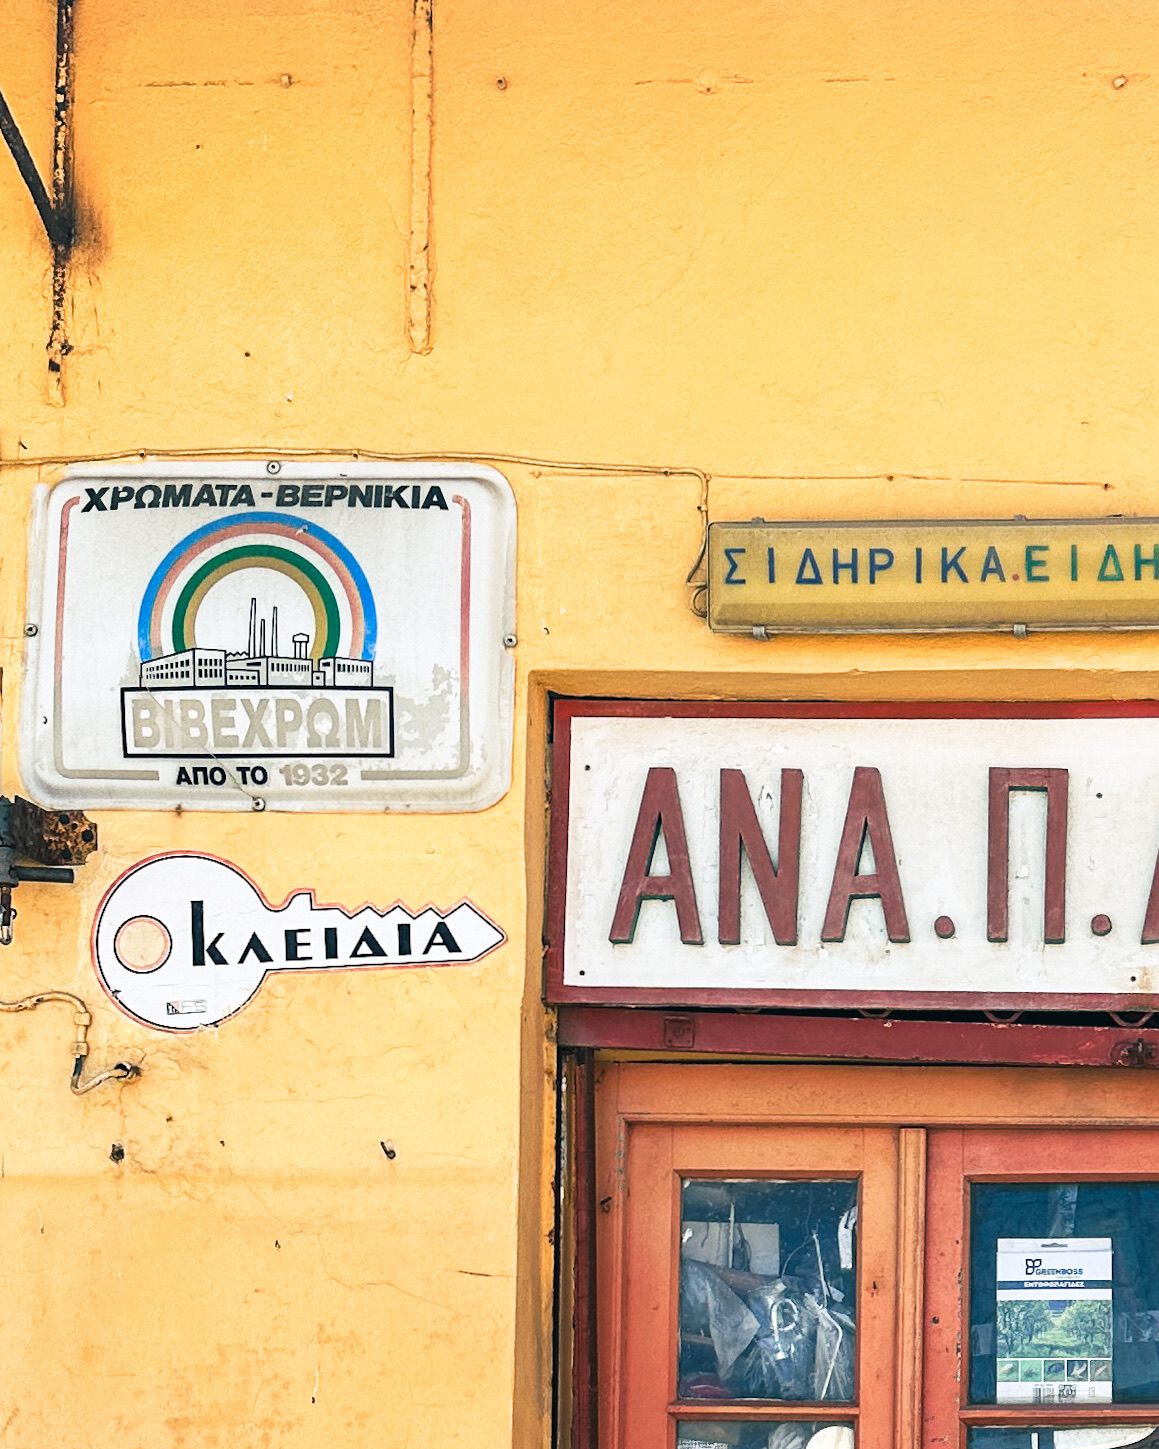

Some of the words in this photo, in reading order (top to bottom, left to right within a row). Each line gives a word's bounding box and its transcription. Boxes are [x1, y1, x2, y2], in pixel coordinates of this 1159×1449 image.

[131, 697, 383, 748] ΒΙΒΕΧΡΩΜ
[176, 766, 226, 785] ΑΠΟ
[236, 766, 268, 785] ΤΟ
[279, 764, 348, 786] 1932
